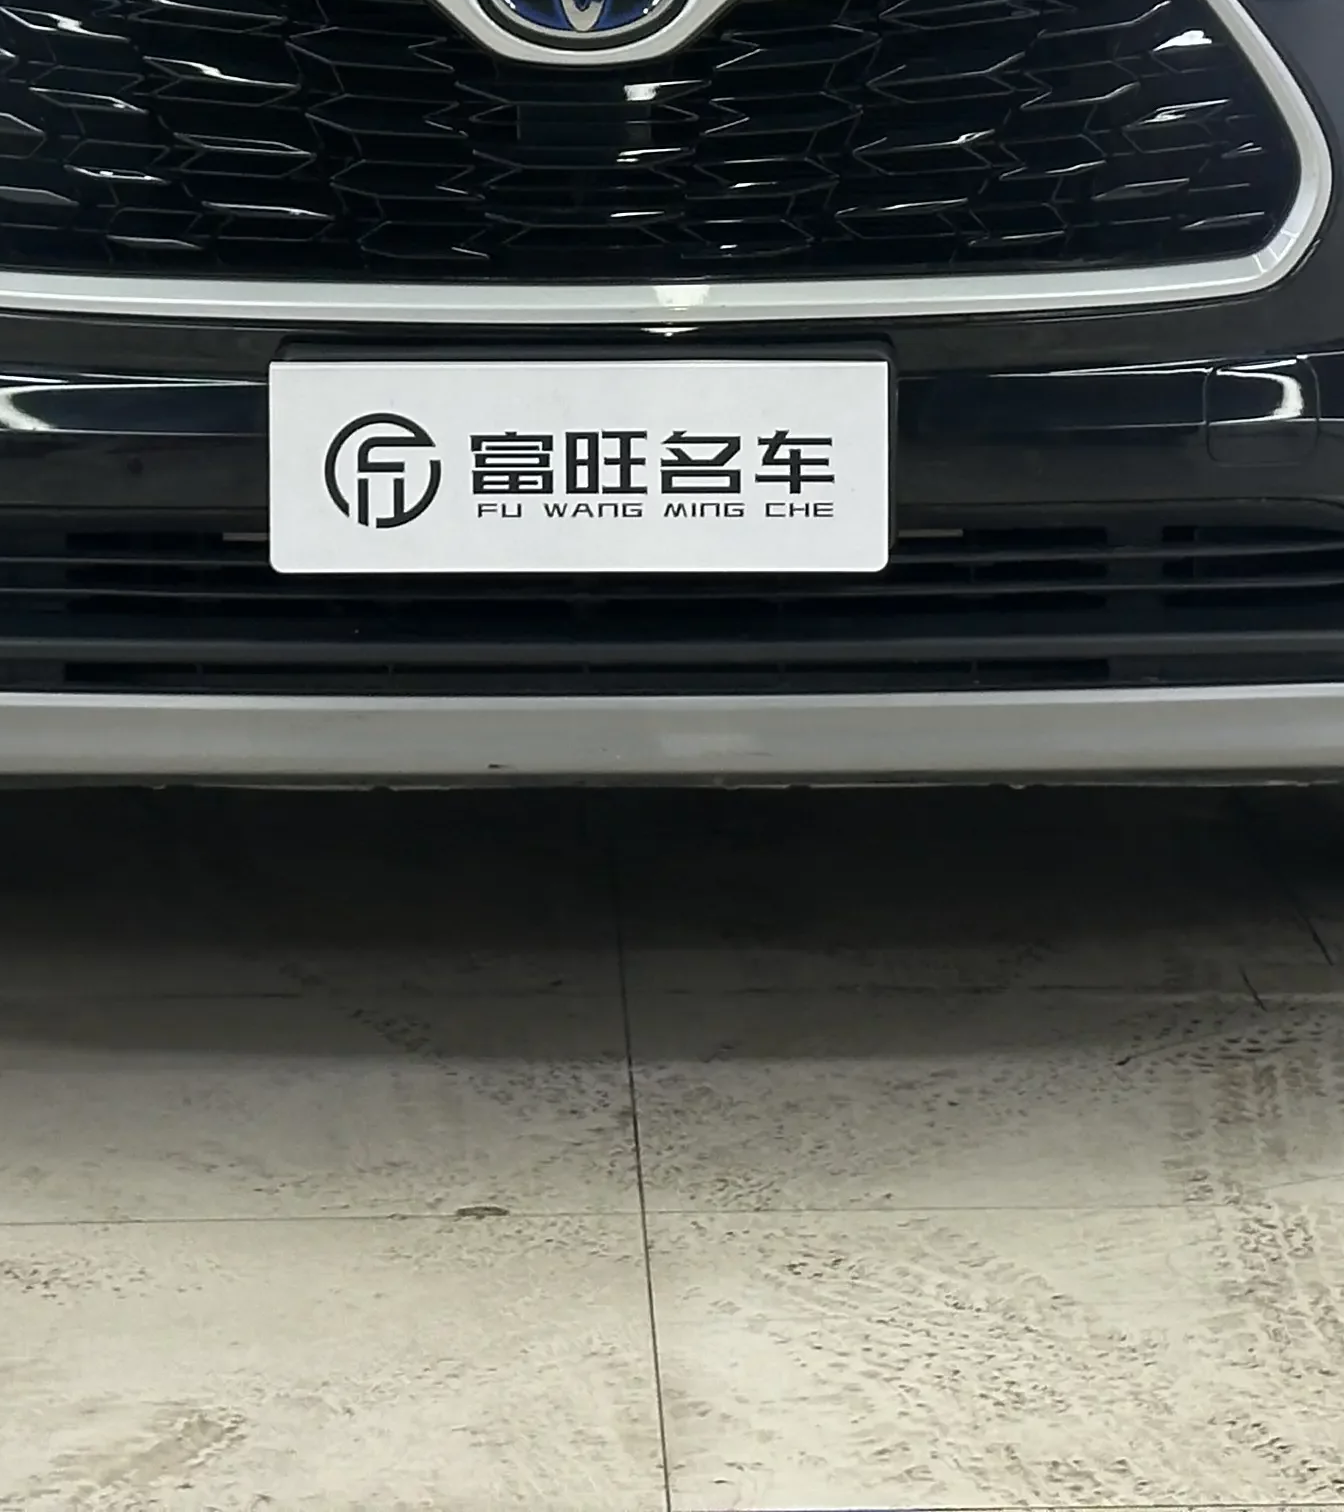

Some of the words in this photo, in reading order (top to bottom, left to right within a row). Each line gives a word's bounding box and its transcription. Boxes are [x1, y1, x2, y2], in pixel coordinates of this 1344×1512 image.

[470, 430, 835, 495] 富旺名车
[477, 502, 522, 518] FU
[544, 502, 643, 518] WANG
[664, 502, 745, 518] MING
[765, 502, 834, 518] CHE
